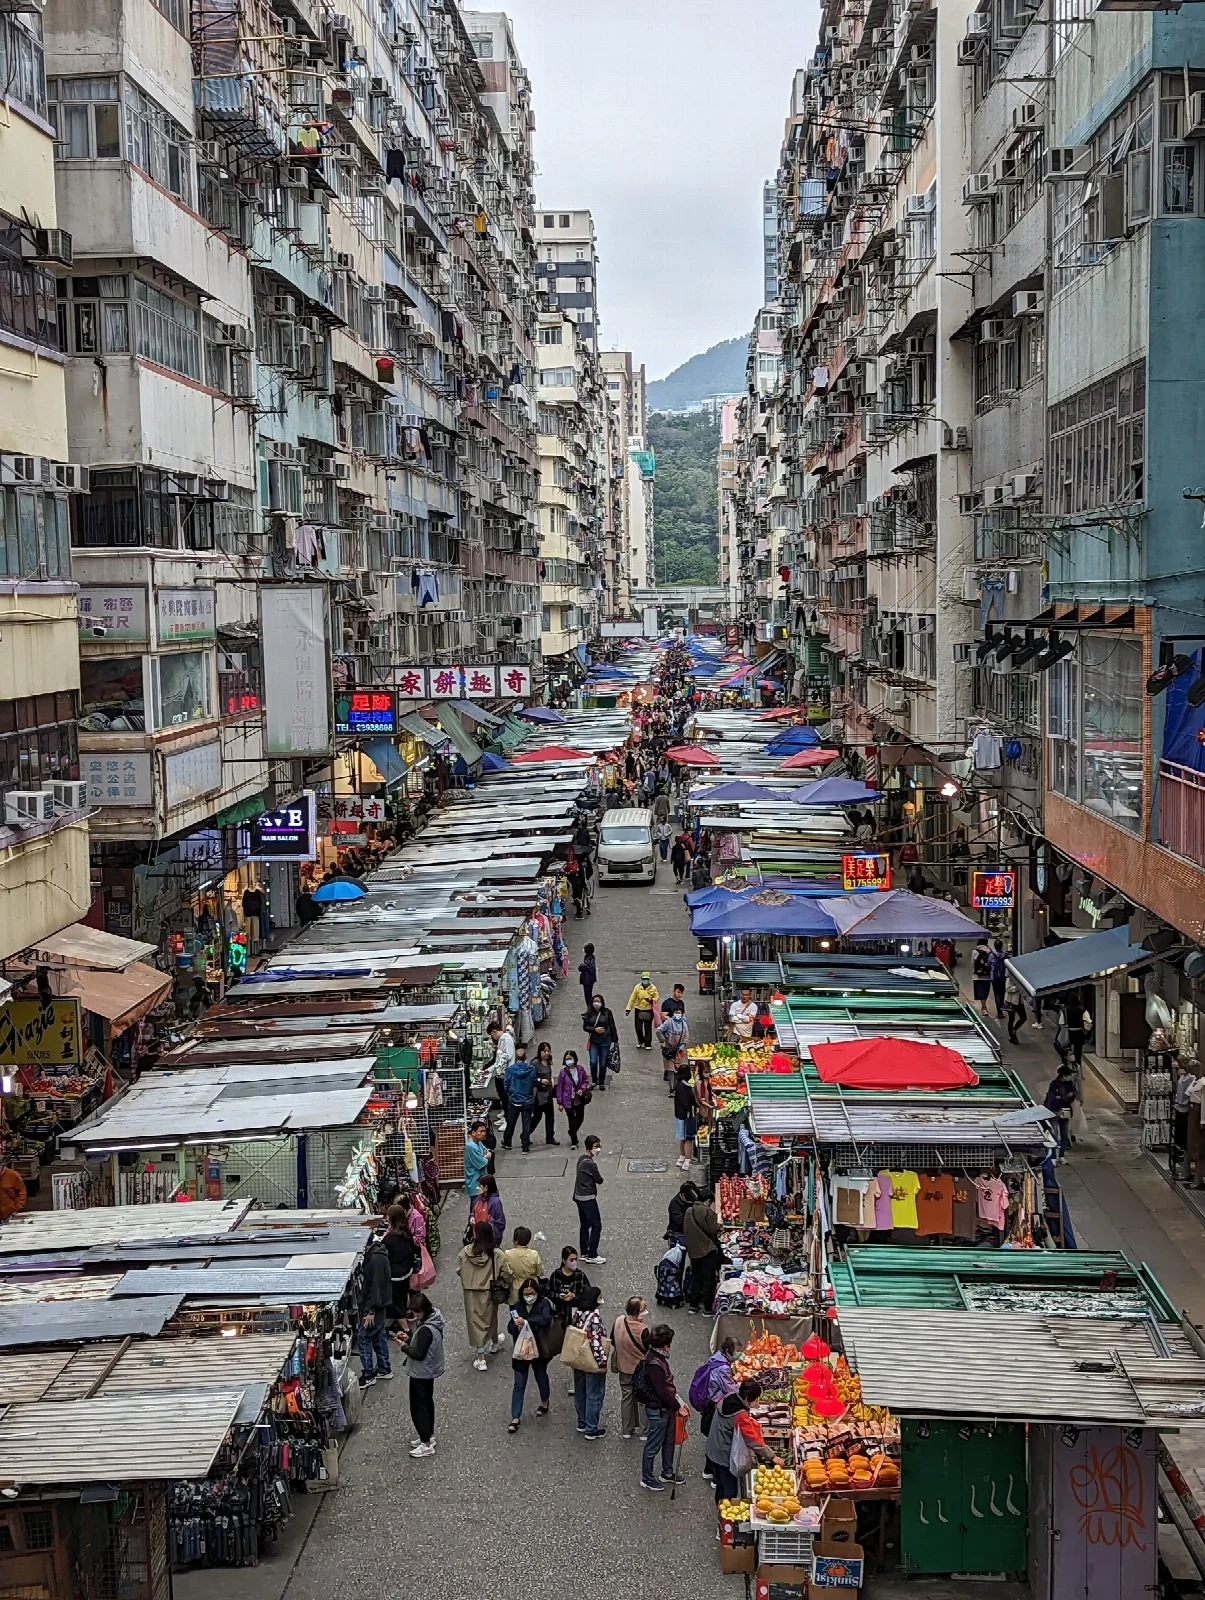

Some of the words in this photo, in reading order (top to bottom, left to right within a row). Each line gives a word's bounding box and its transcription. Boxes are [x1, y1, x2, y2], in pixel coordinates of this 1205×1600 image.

[846, 878, 887, 889] 91755993
[975, 896, 1013, 906] 91755993
[816, 1573, 860, 1587] Sunkist
